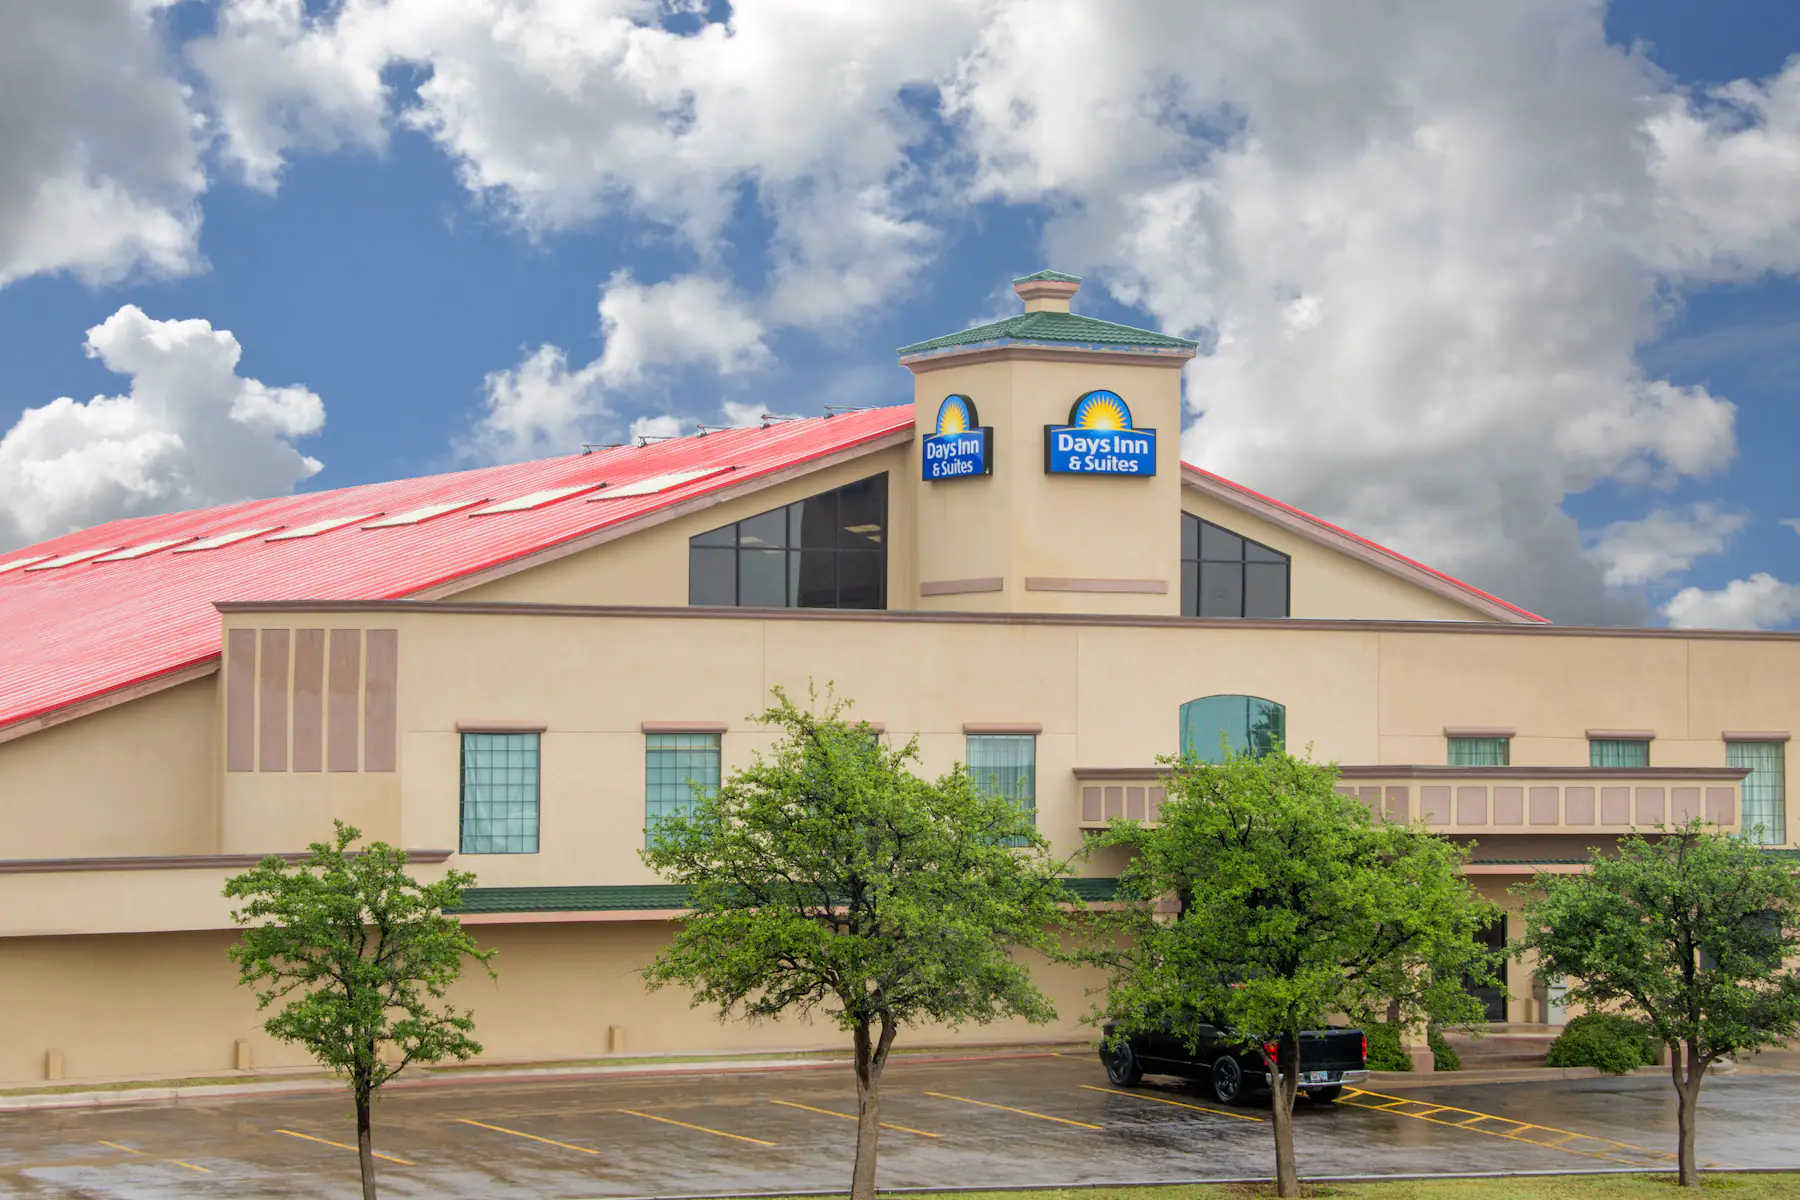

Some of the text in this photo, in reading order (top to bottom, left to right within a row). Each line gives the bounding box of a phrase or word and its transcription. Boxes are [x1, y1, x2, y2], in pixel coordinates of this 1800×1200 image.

[927, 438, 979, 463] Days Inn
[1058, 434, 1148, 455] Days Inn
[932, 460, 973, 477] & Suites
[1069, 455, 1138, 472] & Suites
